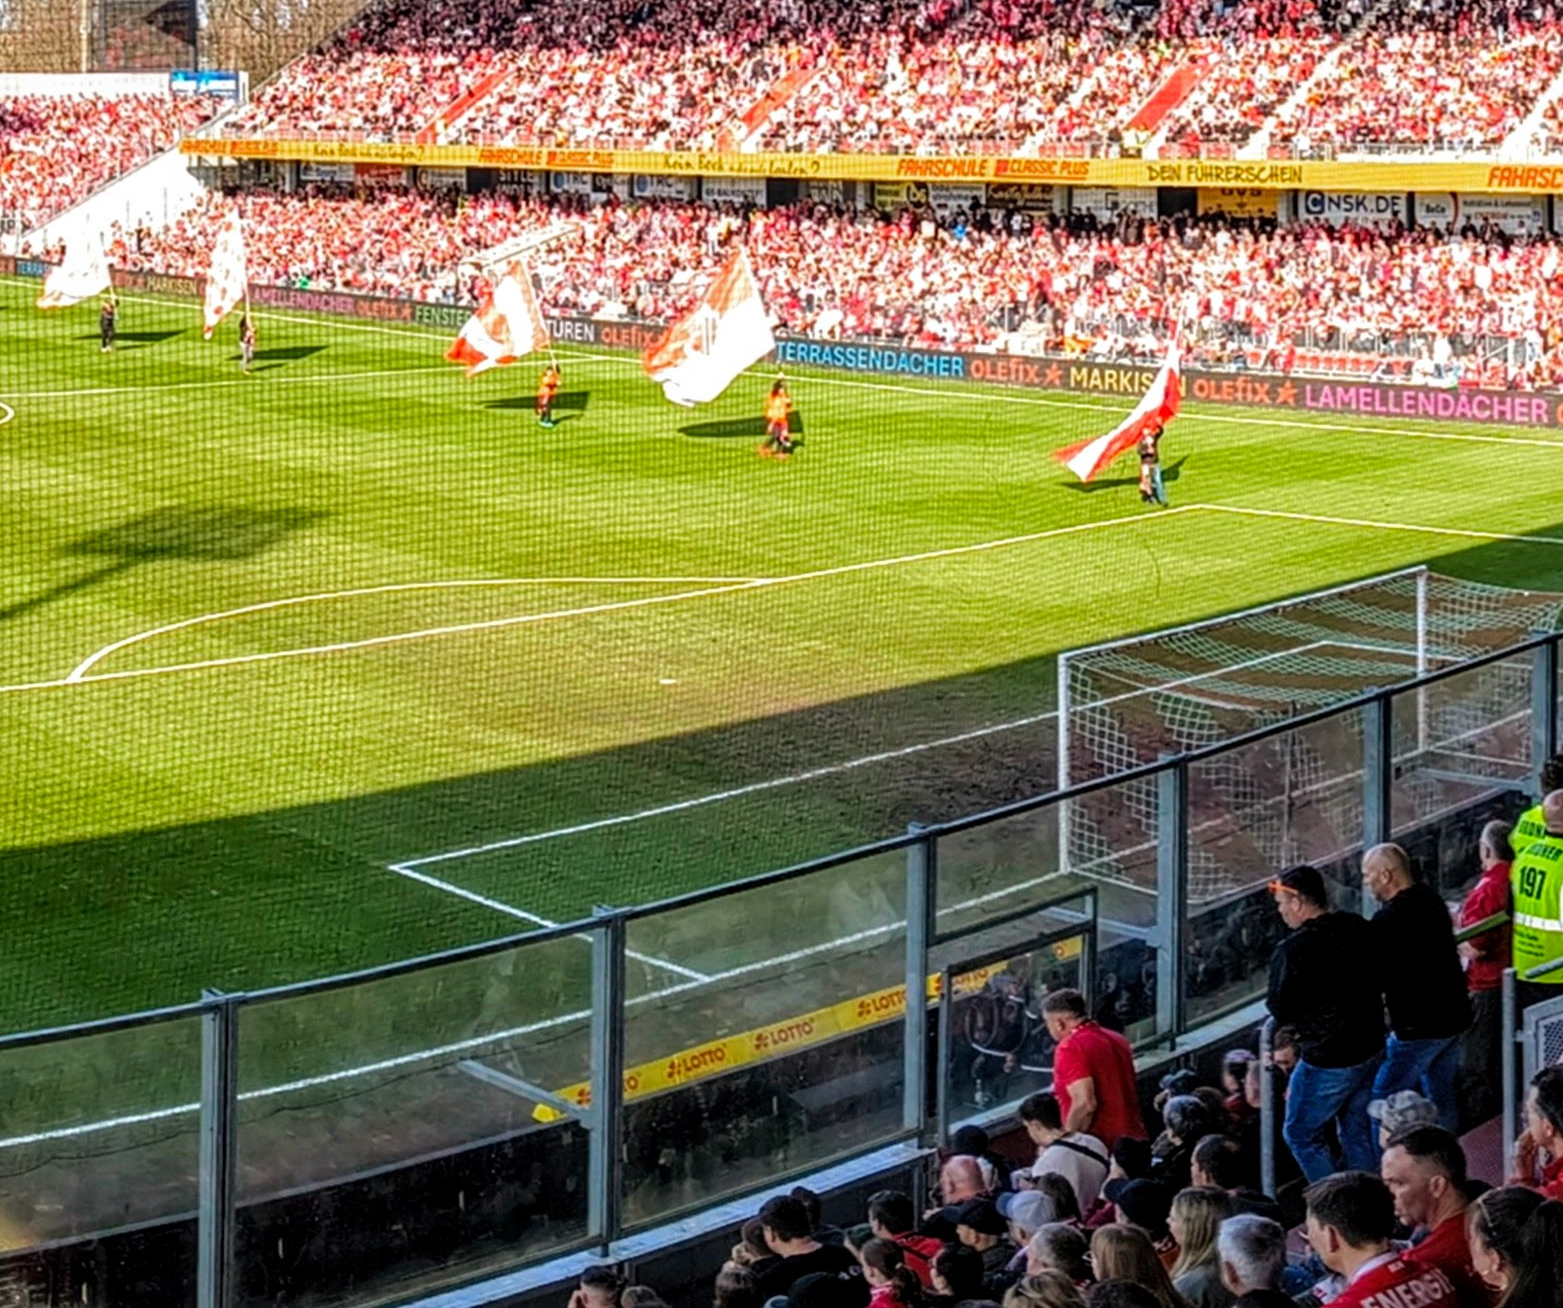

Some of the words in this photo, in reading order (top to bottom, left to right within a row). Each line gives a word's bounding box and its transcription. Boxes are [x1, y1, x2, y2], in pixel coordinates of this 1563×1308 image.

[896, 159, 987, 177] FAHRSCHULE
[1008, 160, 1056, 176] CLASSIC
[1059, 161, 1090, 175] PLUS
[1147, 164, 1182, 182] DEIN
[1186, 162, 1303, 183] FÜHRERSCHEIN
[1519, 865, 1547, 900] 197
[769, 1021, 814, 1045] LOTTO
[683, 1047, 726, 1072] LOTTO
